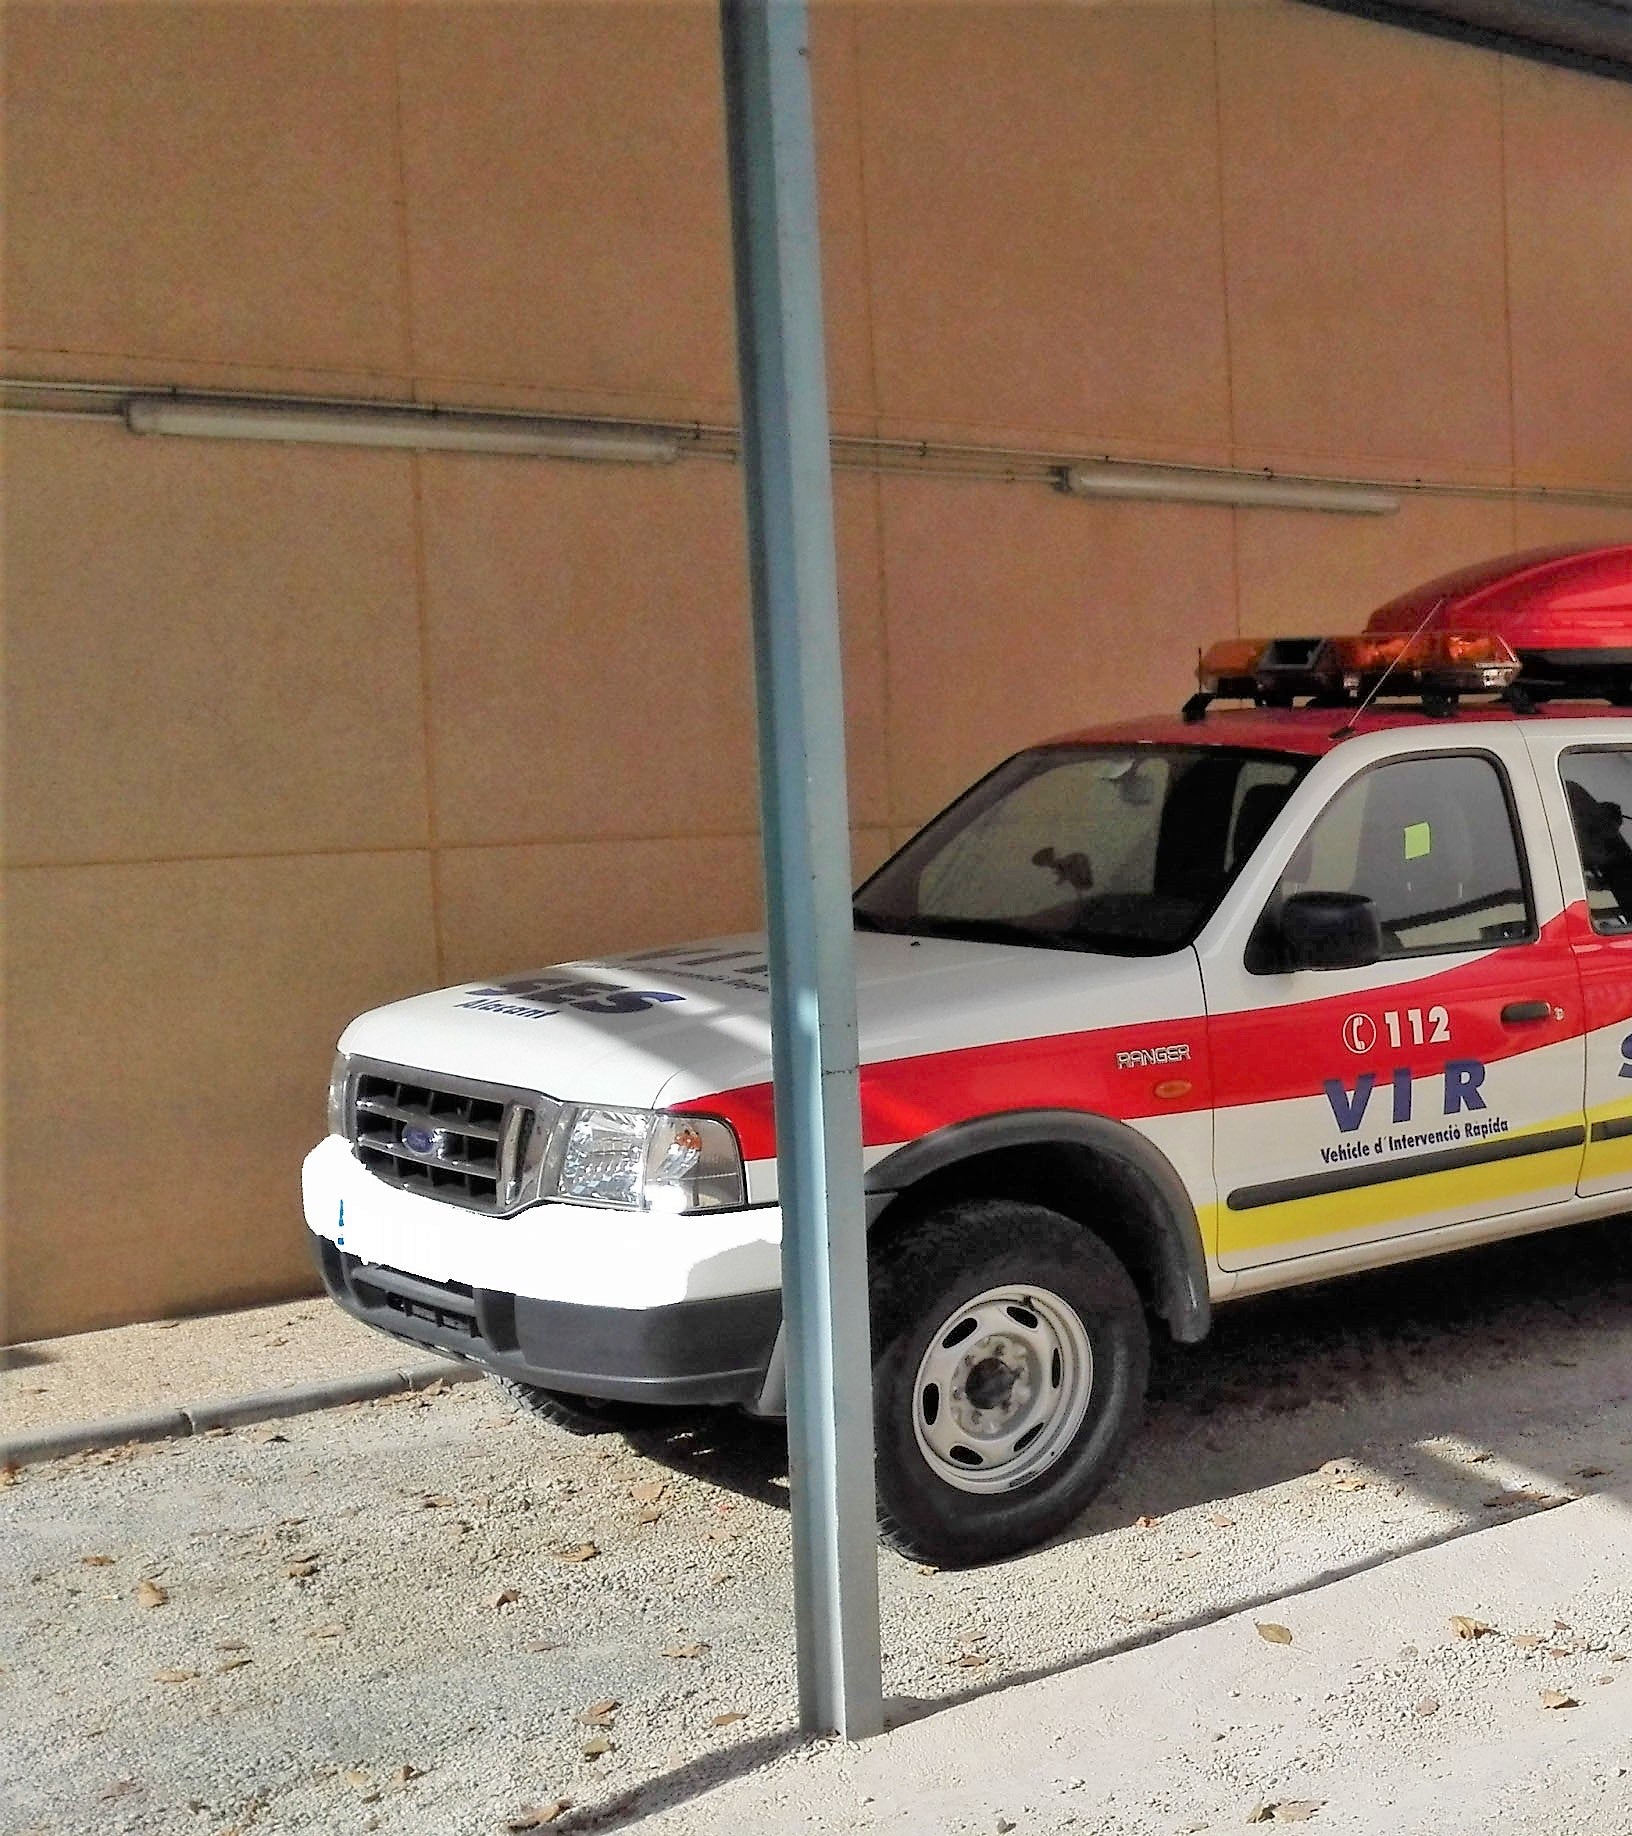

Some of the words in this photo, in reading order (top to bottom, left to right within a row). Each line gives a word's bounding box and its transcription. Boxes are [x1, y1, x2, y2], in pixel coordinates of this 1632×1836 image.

[464, 978, 687, 1014] SES
[453, 998, 563, 1020] Alacant
[1384, 1006, 1451, 1048] 112
[1116, 1044, 1191, 1069] RANGER
[1320, 1141, 1370, 1163] Vehicle
